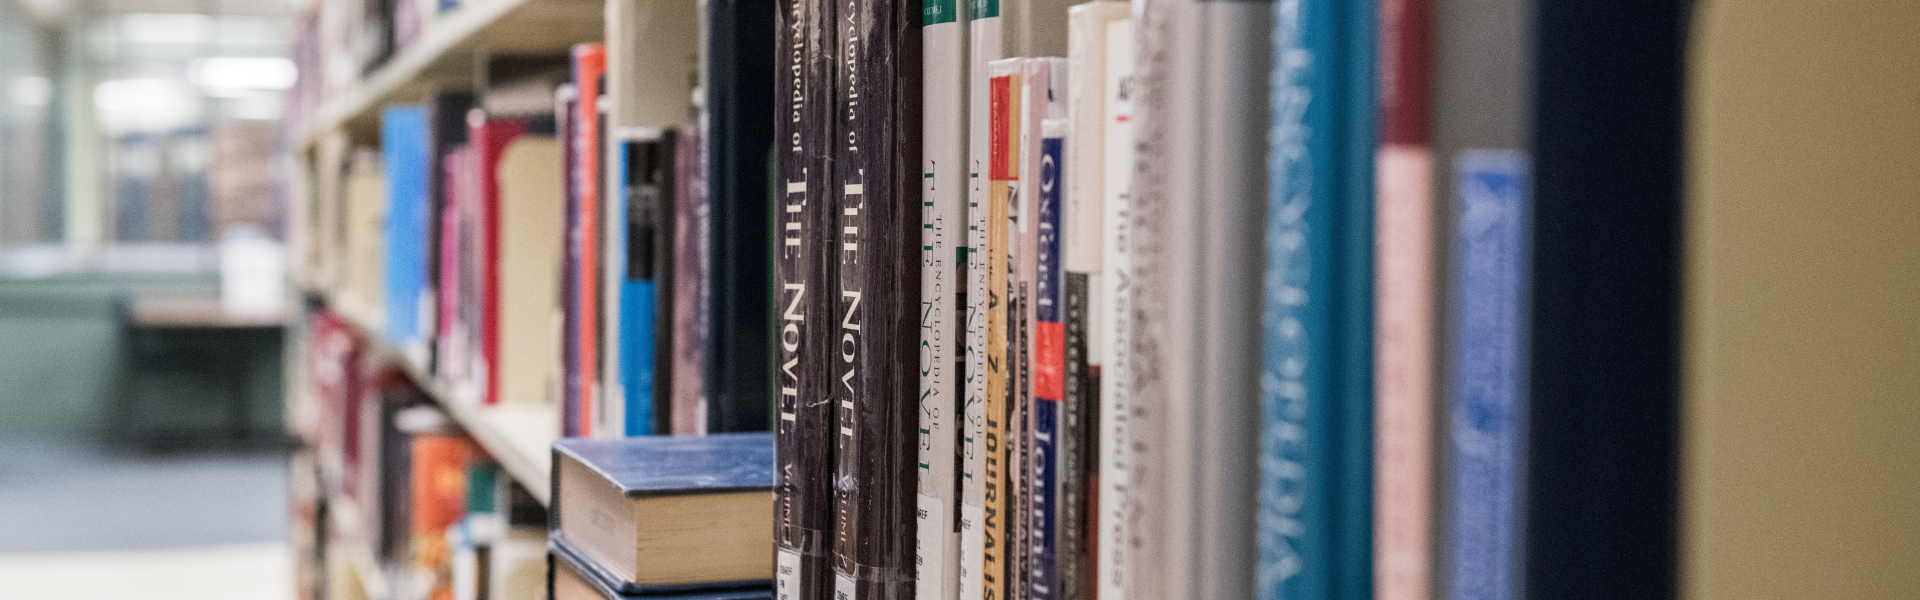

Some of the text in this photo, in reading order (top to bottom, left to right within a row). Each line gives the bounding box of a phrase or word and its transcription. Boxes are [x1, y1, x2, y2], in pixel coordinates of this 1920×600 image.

[792, 132, 803, 154] of
[848, 131, 858, 154] of
[968, 160, 979, 270] THE
[1037, 154, 1055, 306] Oxford
[780, 279, 805, 435] NOVEL
[918, 160, 935, 482] THE NOVEL
[933, 260, 942, 397] ENCYCLOPEDIA
[976, 263, 985, 404] ENCYCLOPEDIA
[989, 290, 999, 310] A
[839, 288, 861, 449] NOVEL
[932, 407, 940, 430] OF
[988, 354, 999, 374] Z
[1112, 191, 1131, 588] The Associated Press
[975, 415, 983, 439] OF
